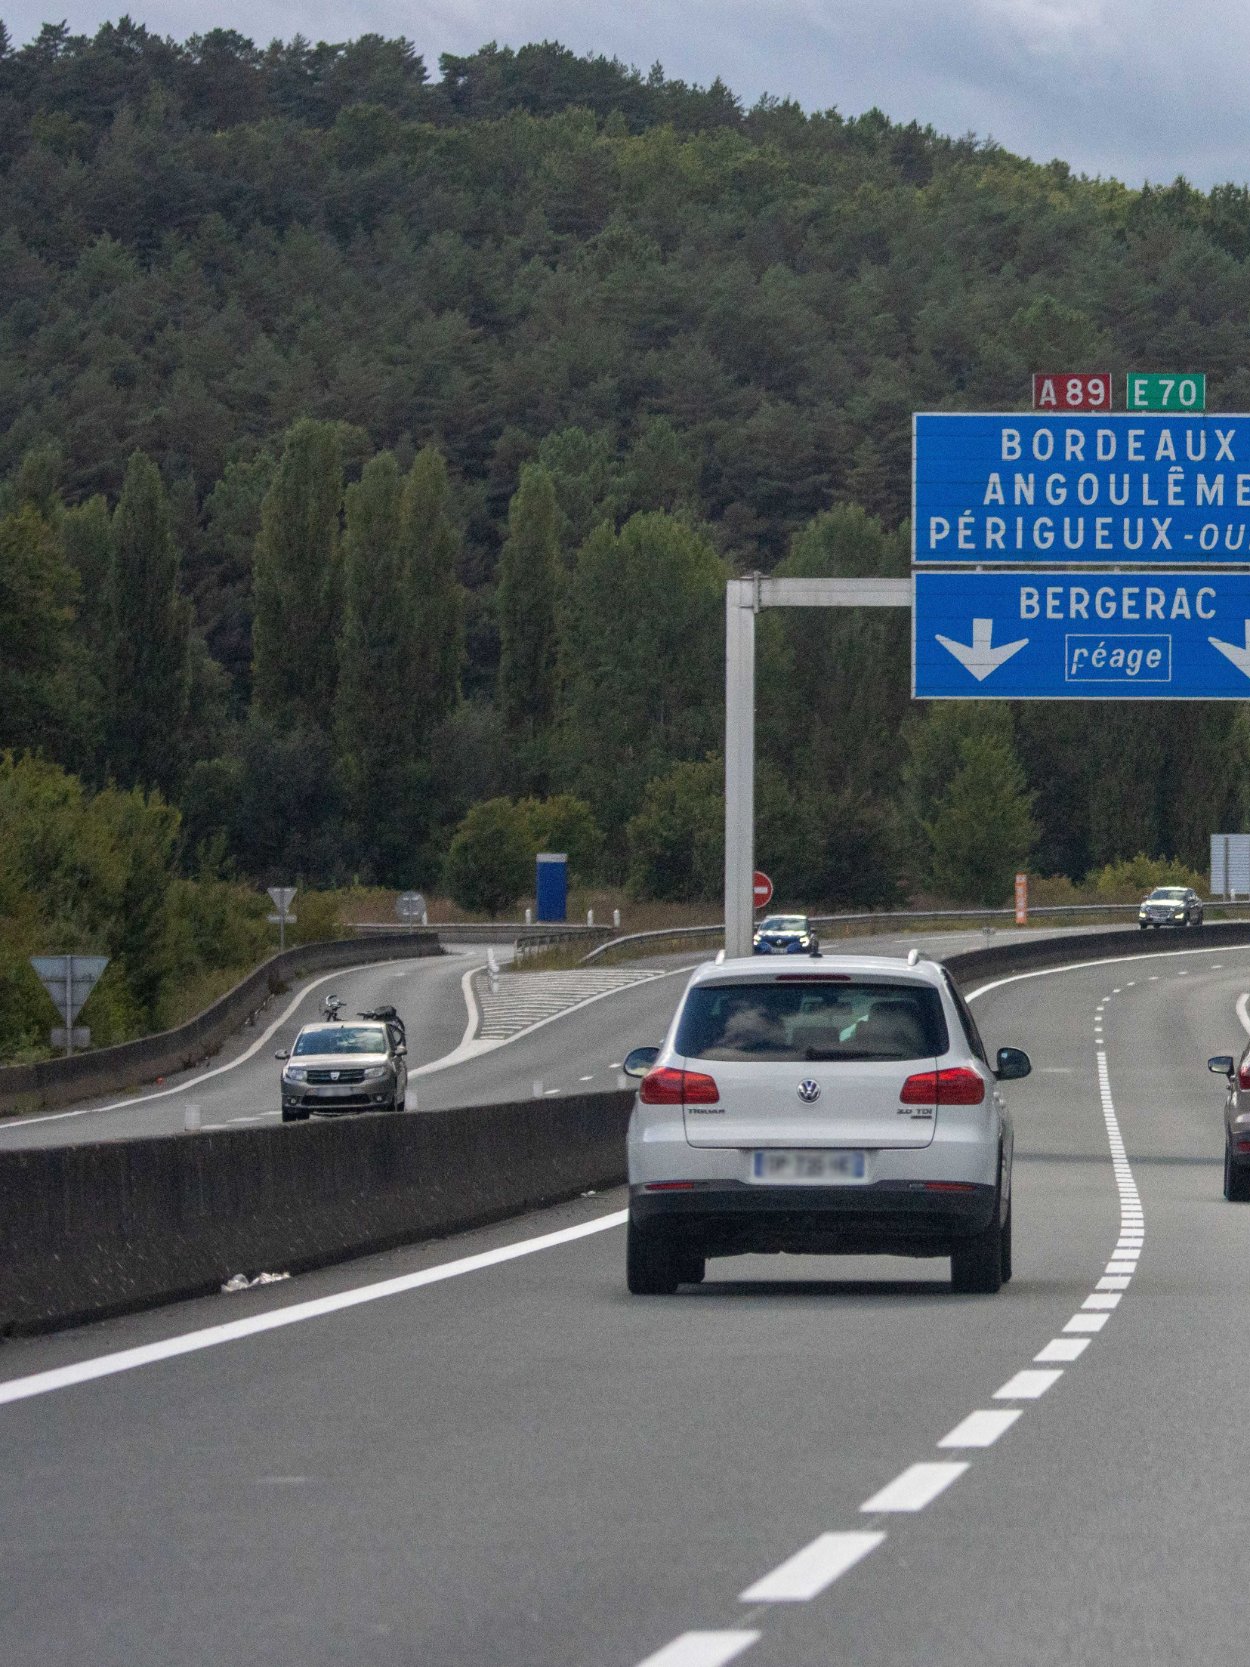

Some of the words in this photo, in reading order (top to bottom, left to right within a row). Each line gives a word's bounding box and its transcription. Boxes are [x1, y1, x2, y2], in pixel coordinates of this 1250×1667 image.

[1001, 428, 1236, 462] BORDEAUX
[929, 509, 1173, 550] PÉRIGUEUX
[1019, 586, 1217, 620] BERGERAC
